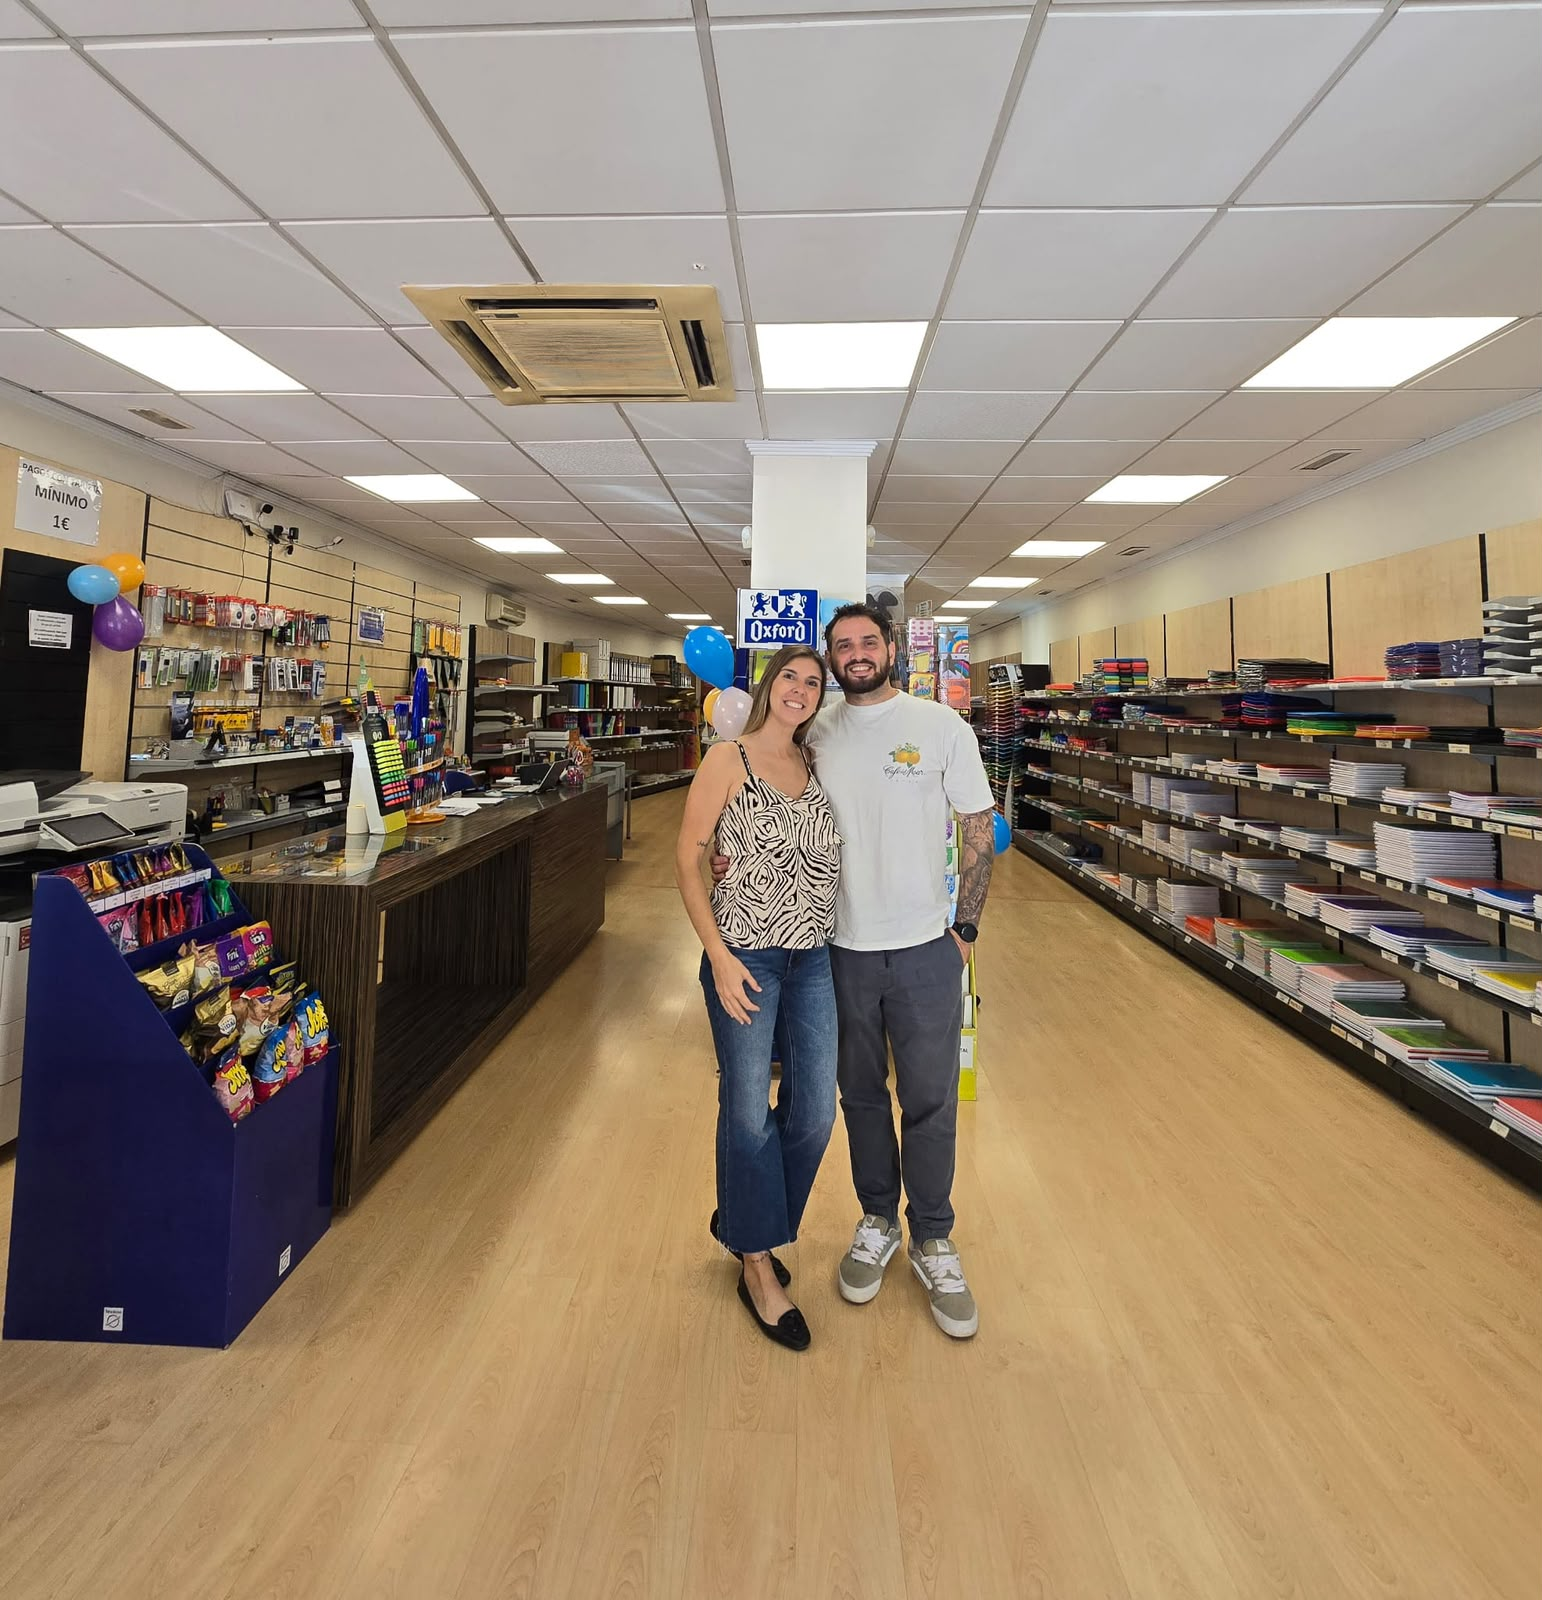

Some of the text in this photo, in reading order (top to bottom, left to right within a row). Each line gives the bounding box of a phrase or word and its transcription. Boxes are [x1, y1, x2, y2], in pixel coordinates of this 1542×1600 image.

[35, 485, 88, 510] MÍNIMO
[53, 515, 70, 531] 1€
[750, 620, 806, 642] Oxford
